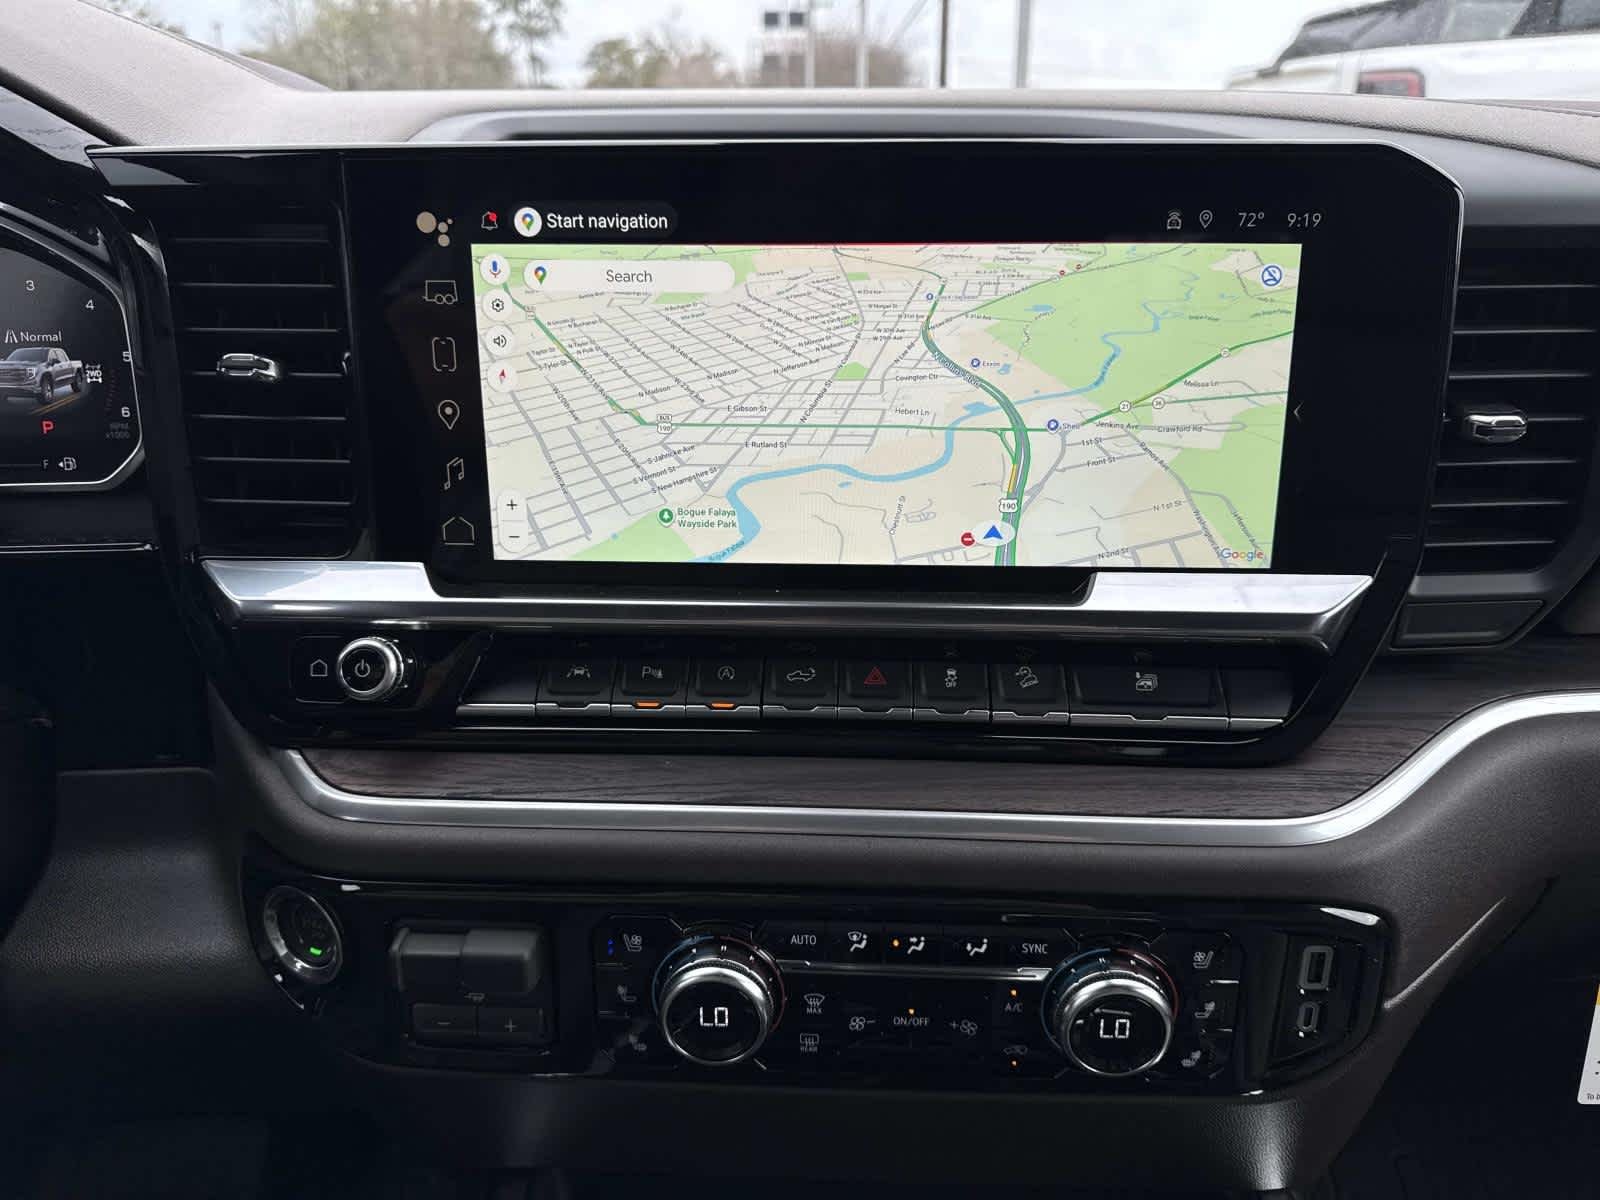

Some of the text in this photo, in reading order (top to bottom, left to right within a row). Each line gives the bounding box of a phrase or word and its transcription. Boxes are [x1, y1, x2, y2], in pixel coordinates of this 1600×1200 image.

[547, 214, 668, 232] Start navigation
[1287, 212, 1322, 228] 9:19
[606, 268, 653, 284] Search
[25, 280, 35, 291] 3
[85, 299, 95, 310] 4
[20, 330, 62, 342] Normal
[122, 351, 131, 362] 5
[780, 360, 807, 372] Jefferson
[86, 369, 102, 377] 2WD
[802, 386, 829, 417] Columbia
[121, 406, 131, 418] 6
[733, 404, 758, 412] Gibson
[895, 407, 930, 416] Hebert Ln
[42, 420, 54, 434] P
[1096, 421, 1124, 431] Jenkins
[1157, 424, 1203, 432] Crawford Rd
[683, 444, 696, 452] Ave
[1138, 441, 1159, 461] Ramos
[43, 460, 49, 469] F
[1087, 456, 1116, 467] Front St
[639, 469, 665, 482] Vermont
[667, 465, 676, 474] St
[657, 482, 673, 491] New
[673, 469, 708, 487] Hampshire
[709, 466, 718, 475] St
[1002, 502, 1016, 510] 190
[1162, 502, 1175, 510] 1st
[677, 507, 736, 519] Bogue Falaya
[887, 502, 904, 535] Chestnut
[678, 519, 737, 529] Wayside Park
[1106, 549, 1119, 557] 2nd
[1120, 547, 1129, 555] St
[1220, 547, 1264, 561] Google
[790, 934, 817, 946] AUTO
[1021, 943, 1048, 954] SYNC
[806, 1007, 823, 1015] MAX
[1005, 1002, 1023, 1013] A/C
[892, 1016, 930, 1027] ON/OFF
